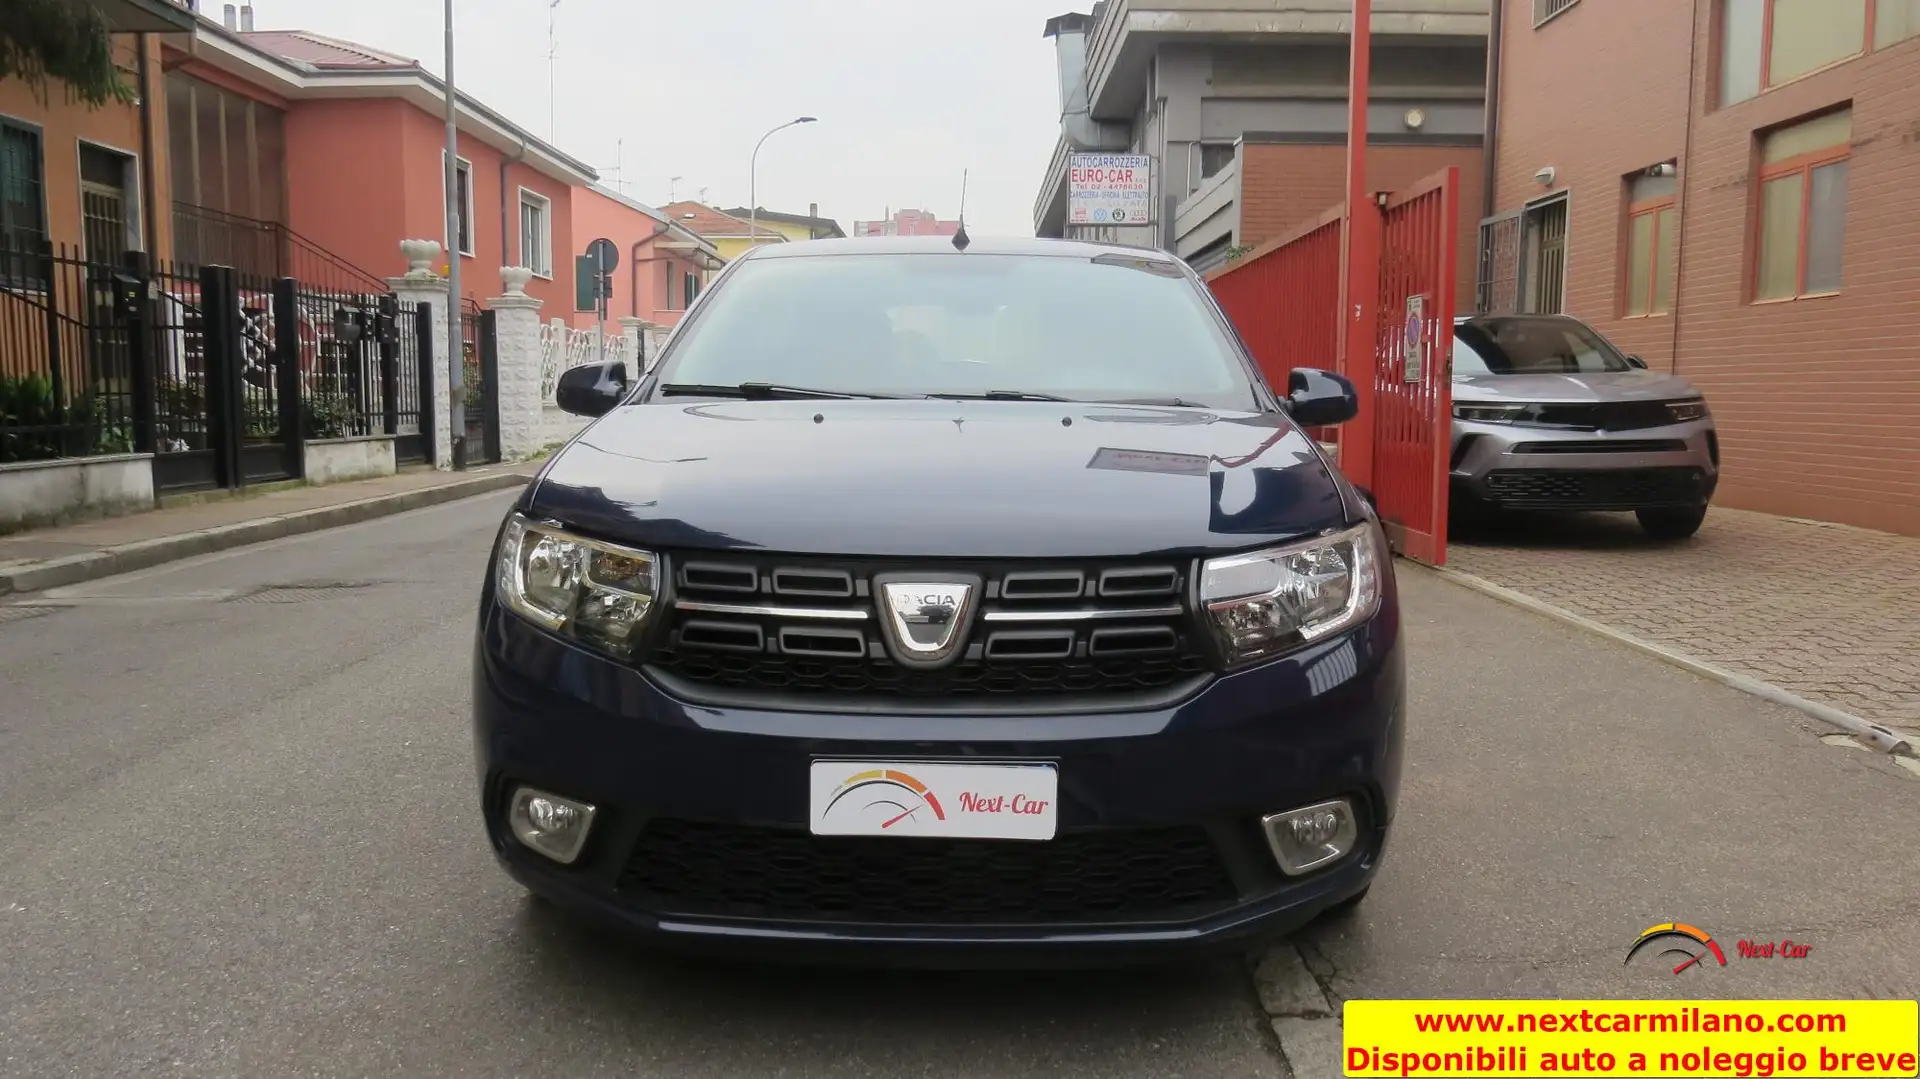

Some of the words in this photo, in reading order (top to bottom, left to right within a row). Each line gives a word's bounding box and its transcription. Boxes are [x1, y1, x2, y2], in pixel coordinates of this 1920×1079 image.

[1071, 156, 1148, 168] AUTOCARROZZERIA
[1071, 169, 1133, 182] EURO-CAR
[958, 791, 1049, 815] Next-Car
